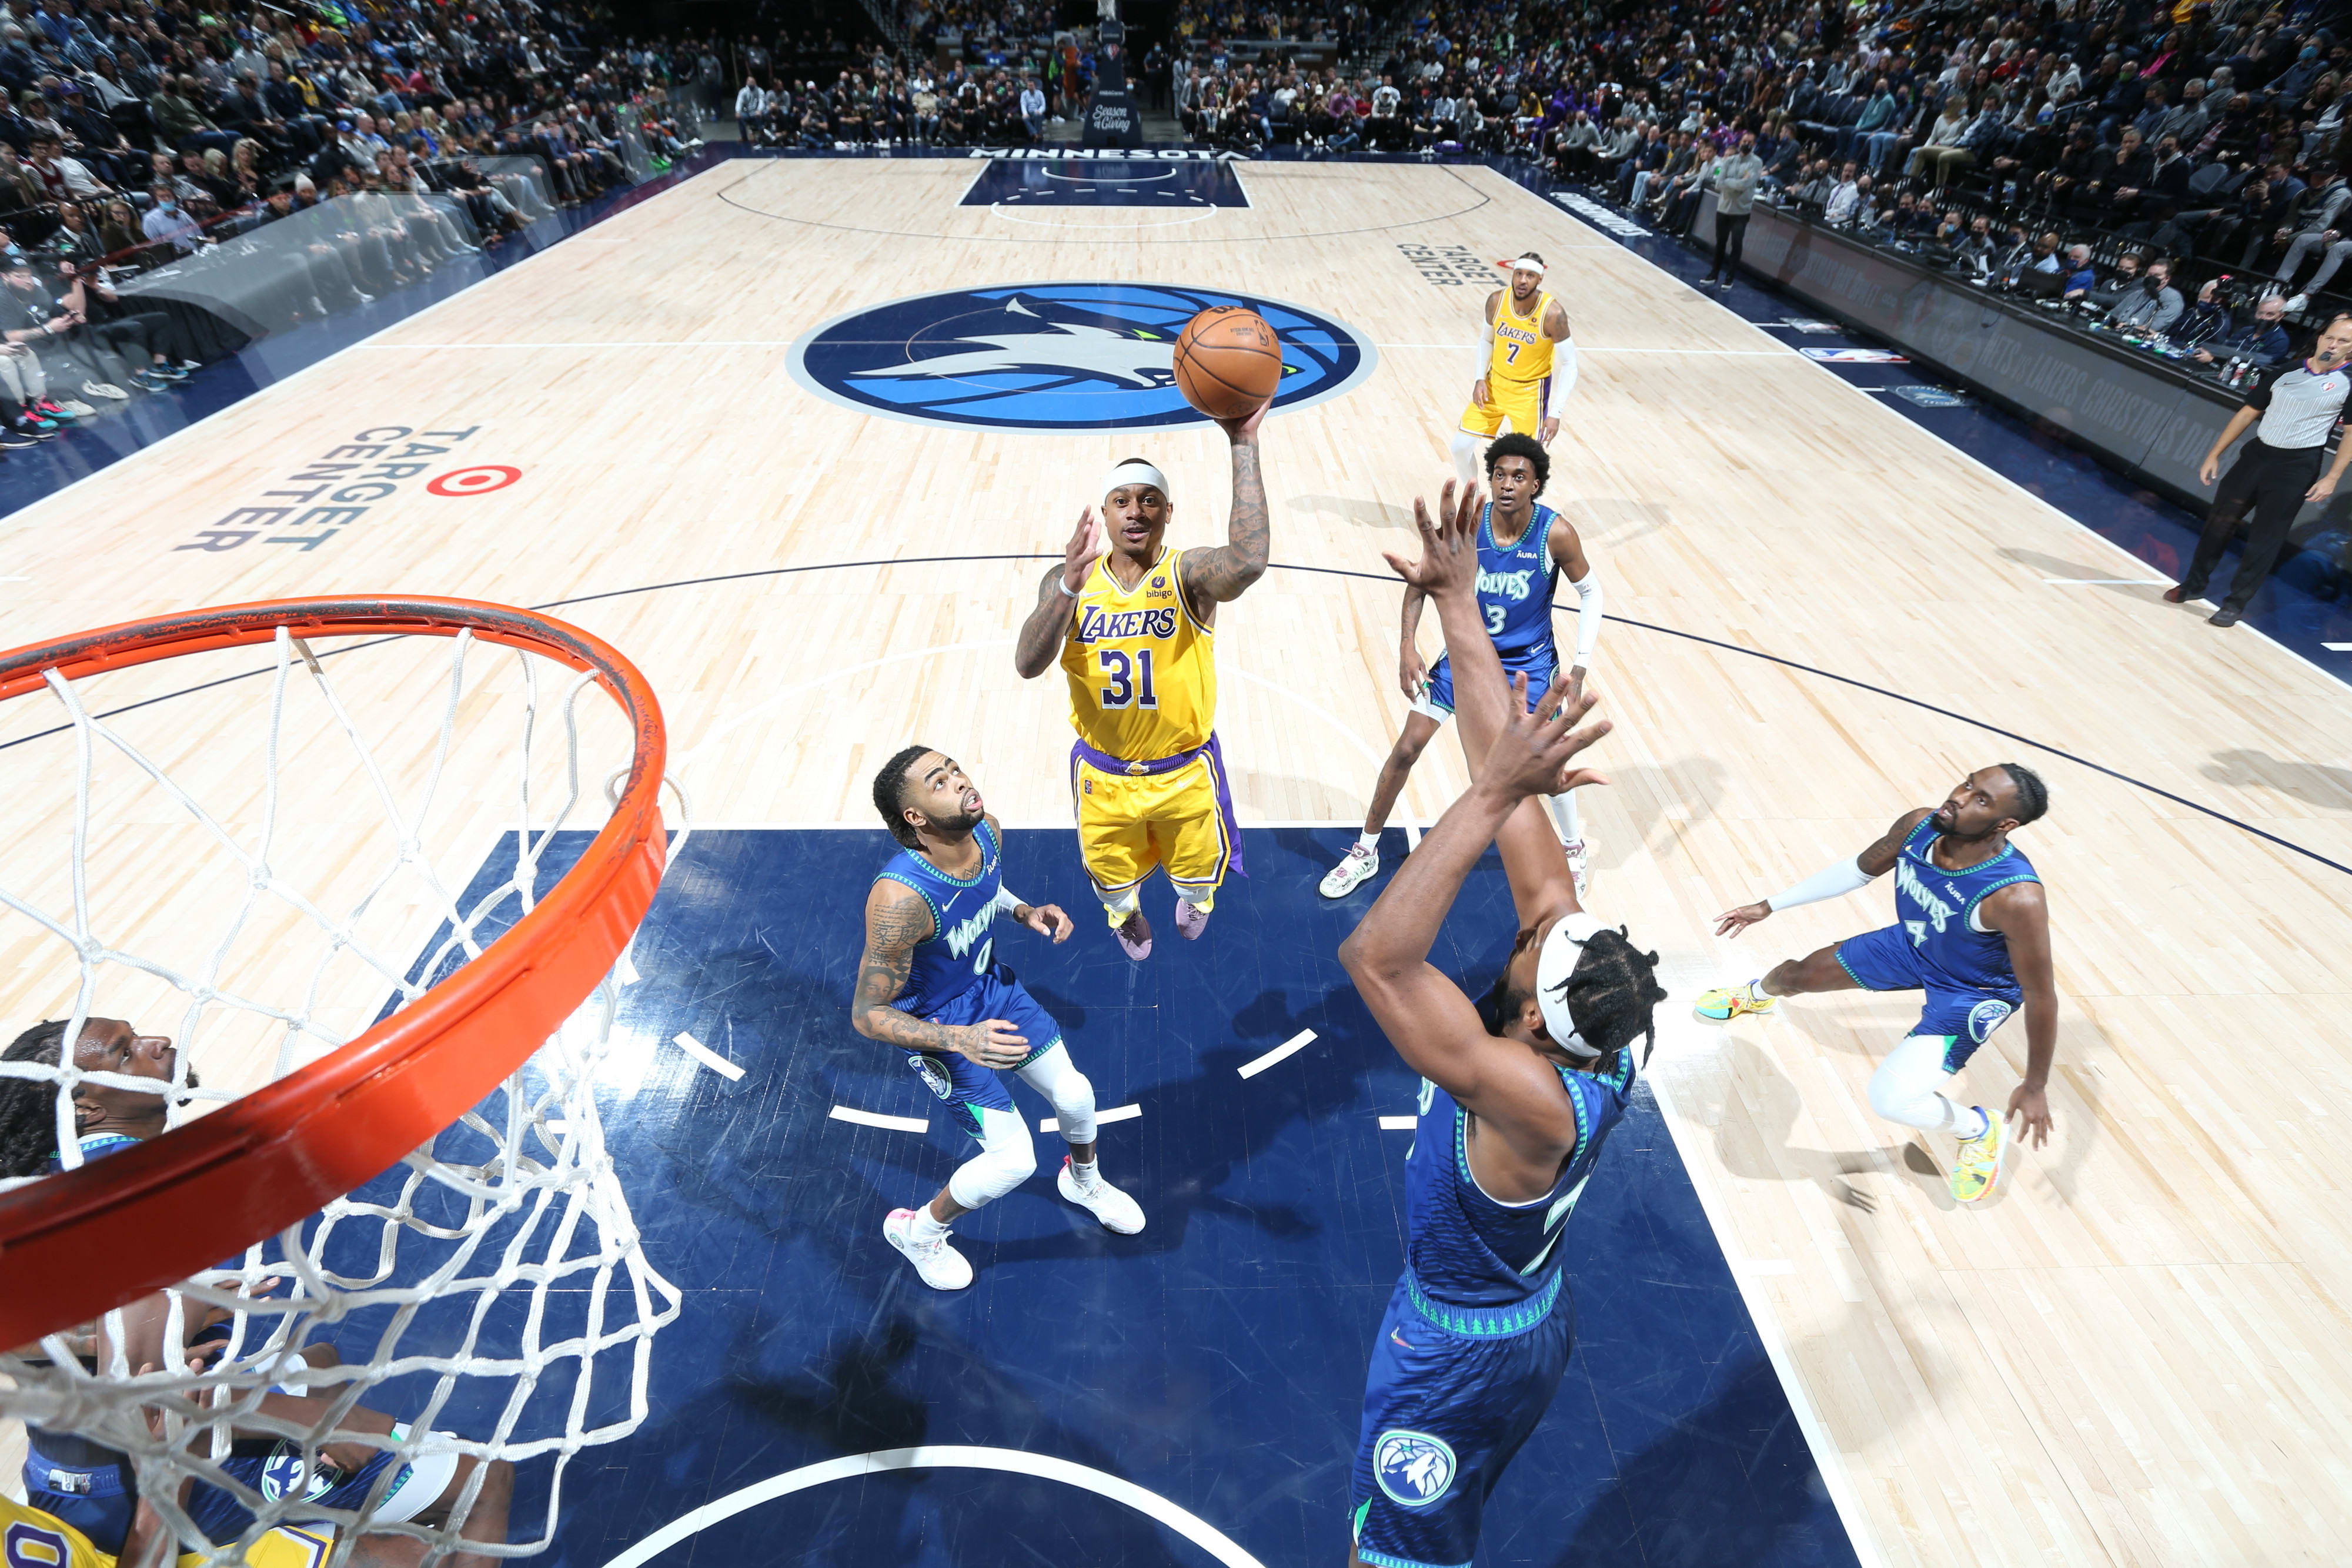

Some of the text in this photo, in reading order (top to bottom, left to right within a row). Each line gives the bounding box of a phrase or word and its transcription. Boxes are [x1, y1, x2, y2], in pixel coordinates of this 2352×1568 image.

[1093, 104, 1127, 119] Season
[1101, 118, 1131, 133] Giving
[969, 148, 1251, 160] MINNESOTA
[1396, 243, 1464, 286] CENTER
[1435, 244, 1508, 287] TARGET
[1496, 320, 1537, 345] LAKERS
[1506, 341, 1521, 366] 7
[171, 426, 414, 552] CENTER
[262, 424, 483, 552] TARGET
[1146, 589, 1172, 599] bibigo
[1073, 605, 1178, 644] LAKERS
[1485, 603, 1507, 634] 3
[1098, 648, 1158, 710] 31
[1896, 857, 1959, 934] WOLVES
[943, 874, 1002, 961] WOLV
[1904, 920, 1929, 948] 4
[973, 937, 993, 976] 0
